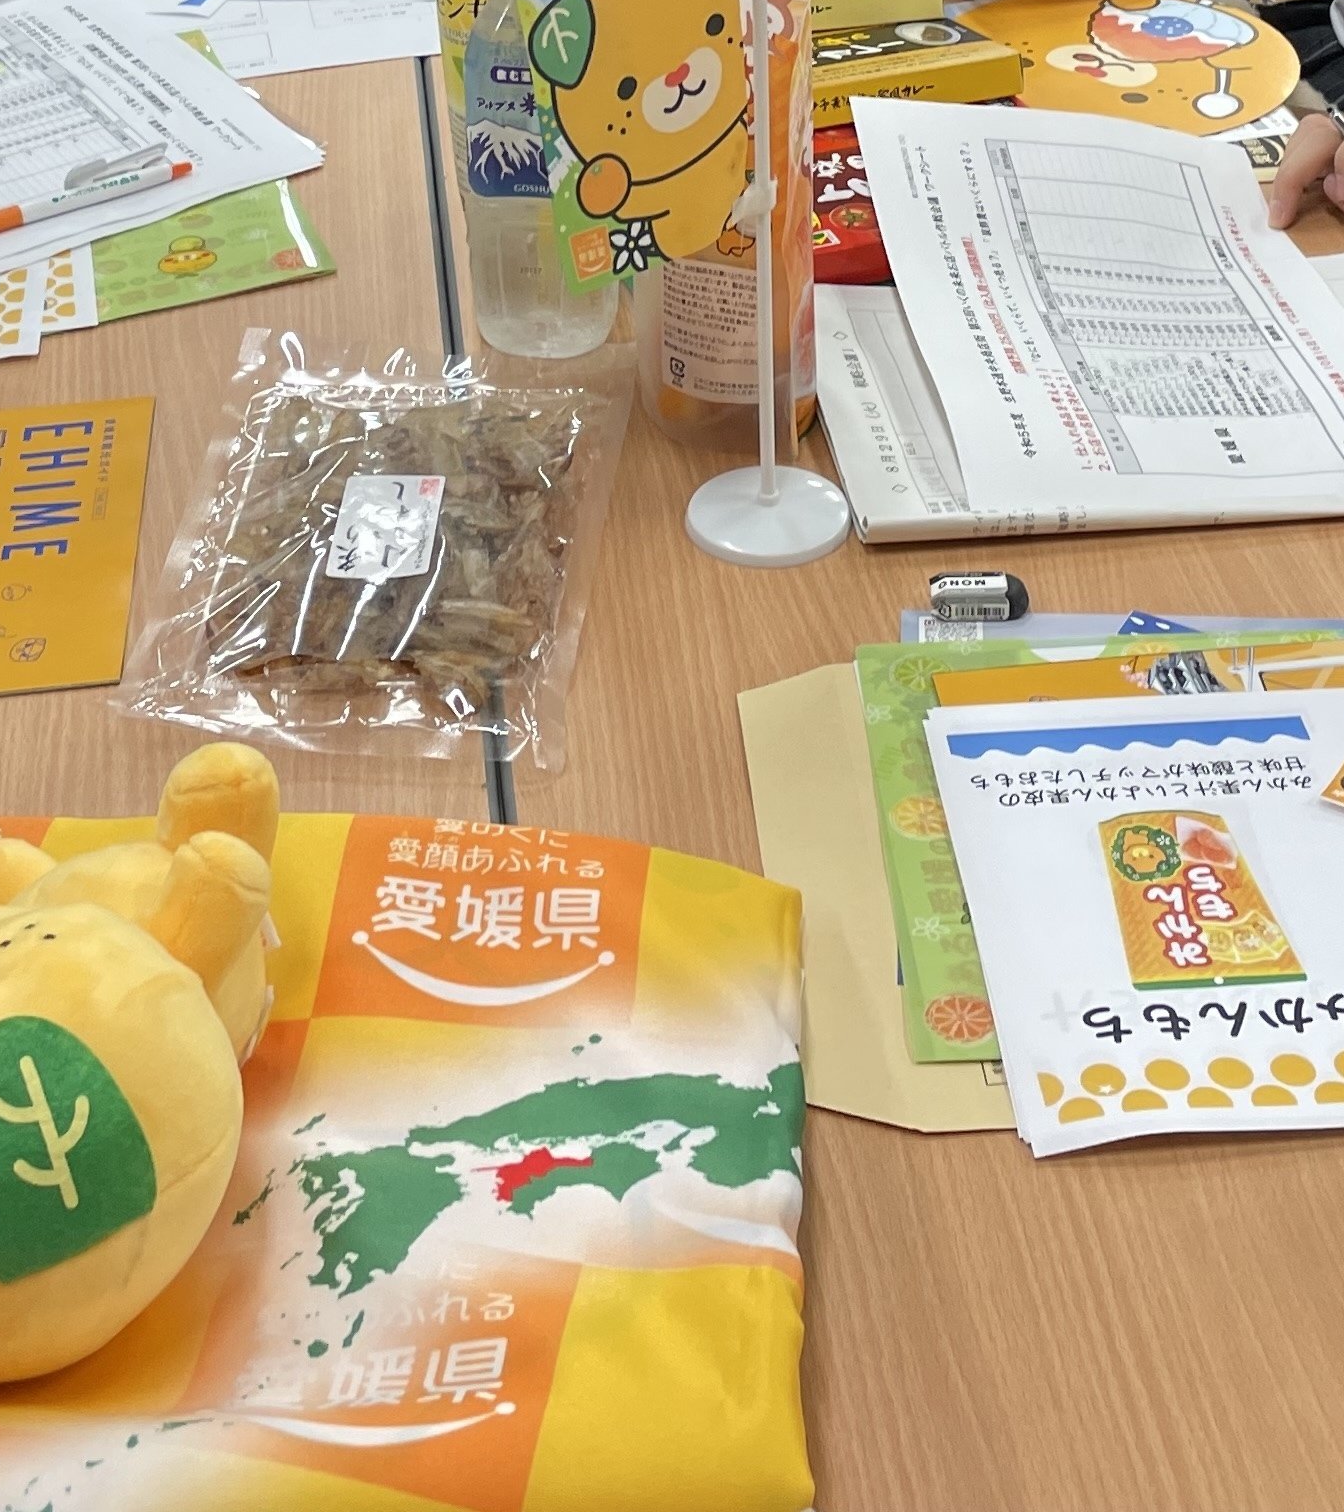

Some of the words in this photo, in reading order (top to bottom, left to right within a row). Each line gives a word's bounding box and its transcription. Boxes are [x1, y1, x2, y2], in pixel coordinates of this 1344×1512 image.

[0, 419, 95, 563] EHIME
[938, 578, 987, 590] MONO
[969, 755, 1307, 791] 甘味と酸味がマッチしたおもち
[997, 774, 1312, 808] みかん果汁といよかん果皮の
[387, 836, 606, 881] 愛顔あふれる
[369, 874, 603, 952] 愛媛県
[1185, 865, 1234, 921] もち
[1147, 885, 1210, 965] みかん
